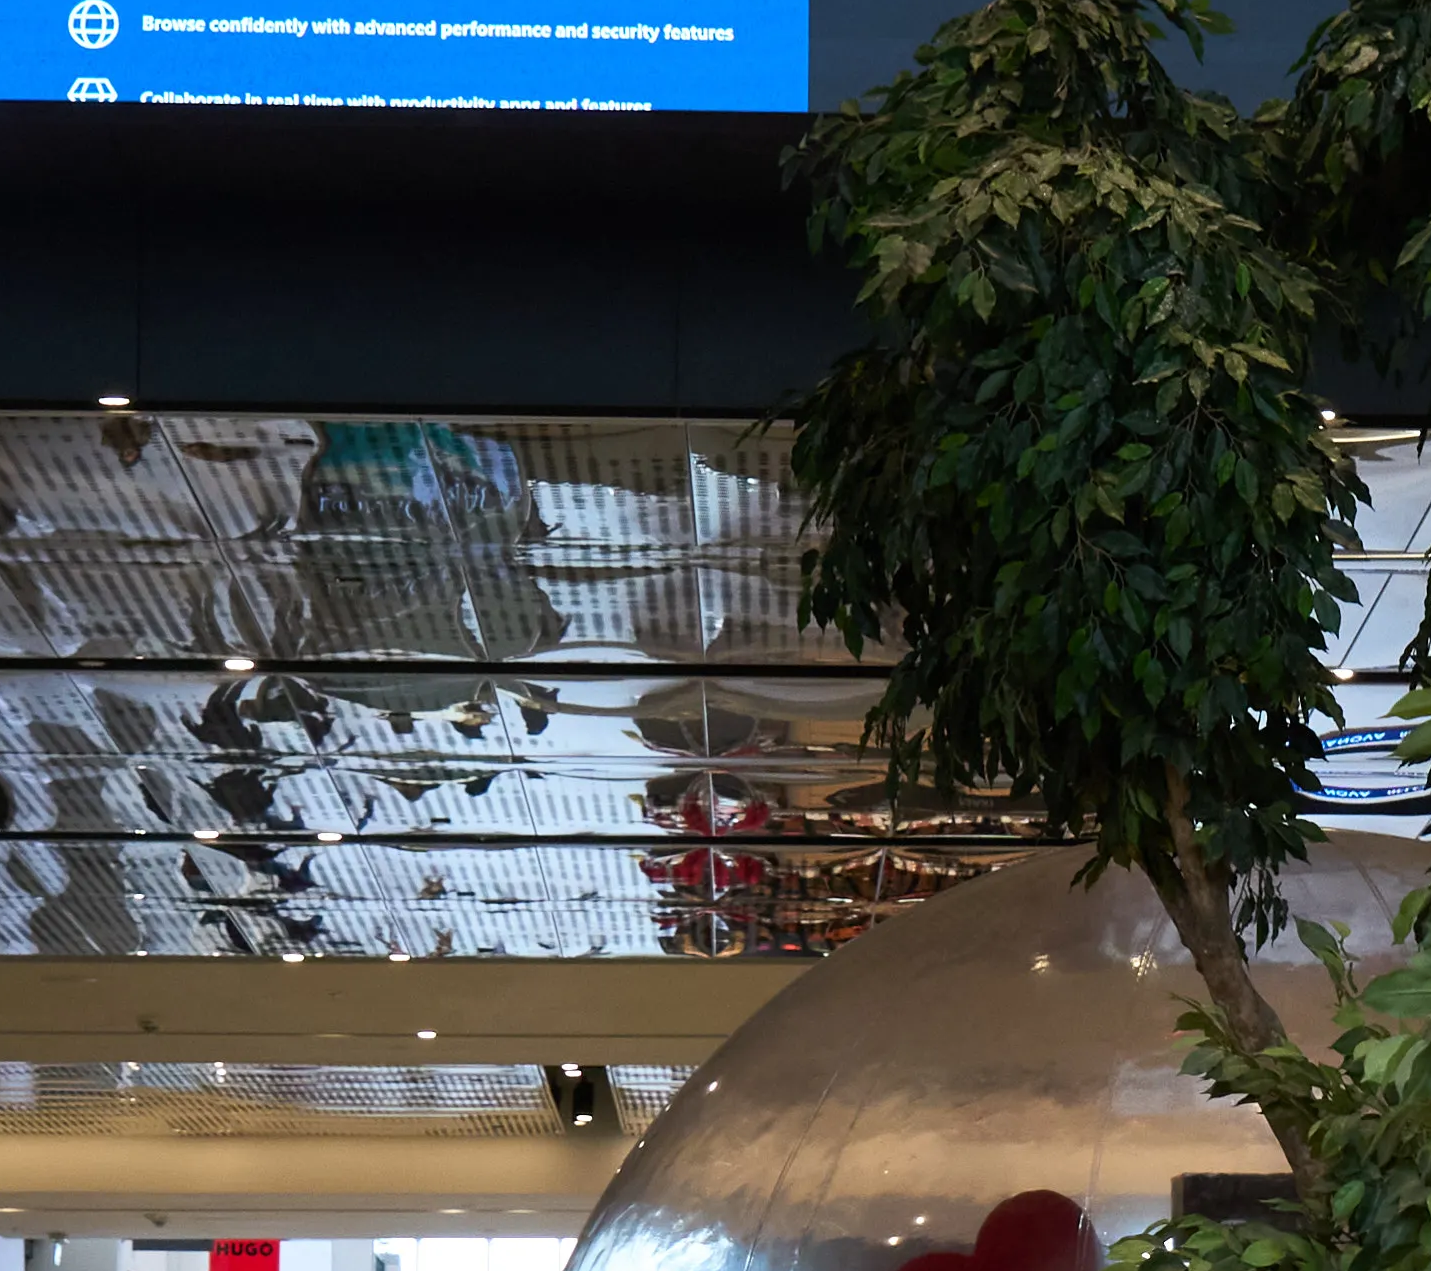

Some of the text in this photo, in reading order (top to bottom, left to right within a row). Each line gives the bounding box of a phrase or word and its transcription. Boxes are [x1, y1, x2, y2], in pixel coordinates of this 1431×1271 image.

[142, 15, 735, 44] Browse confidently with advanced performance and security features
[216, 1241, 274, 1257] HUGO
